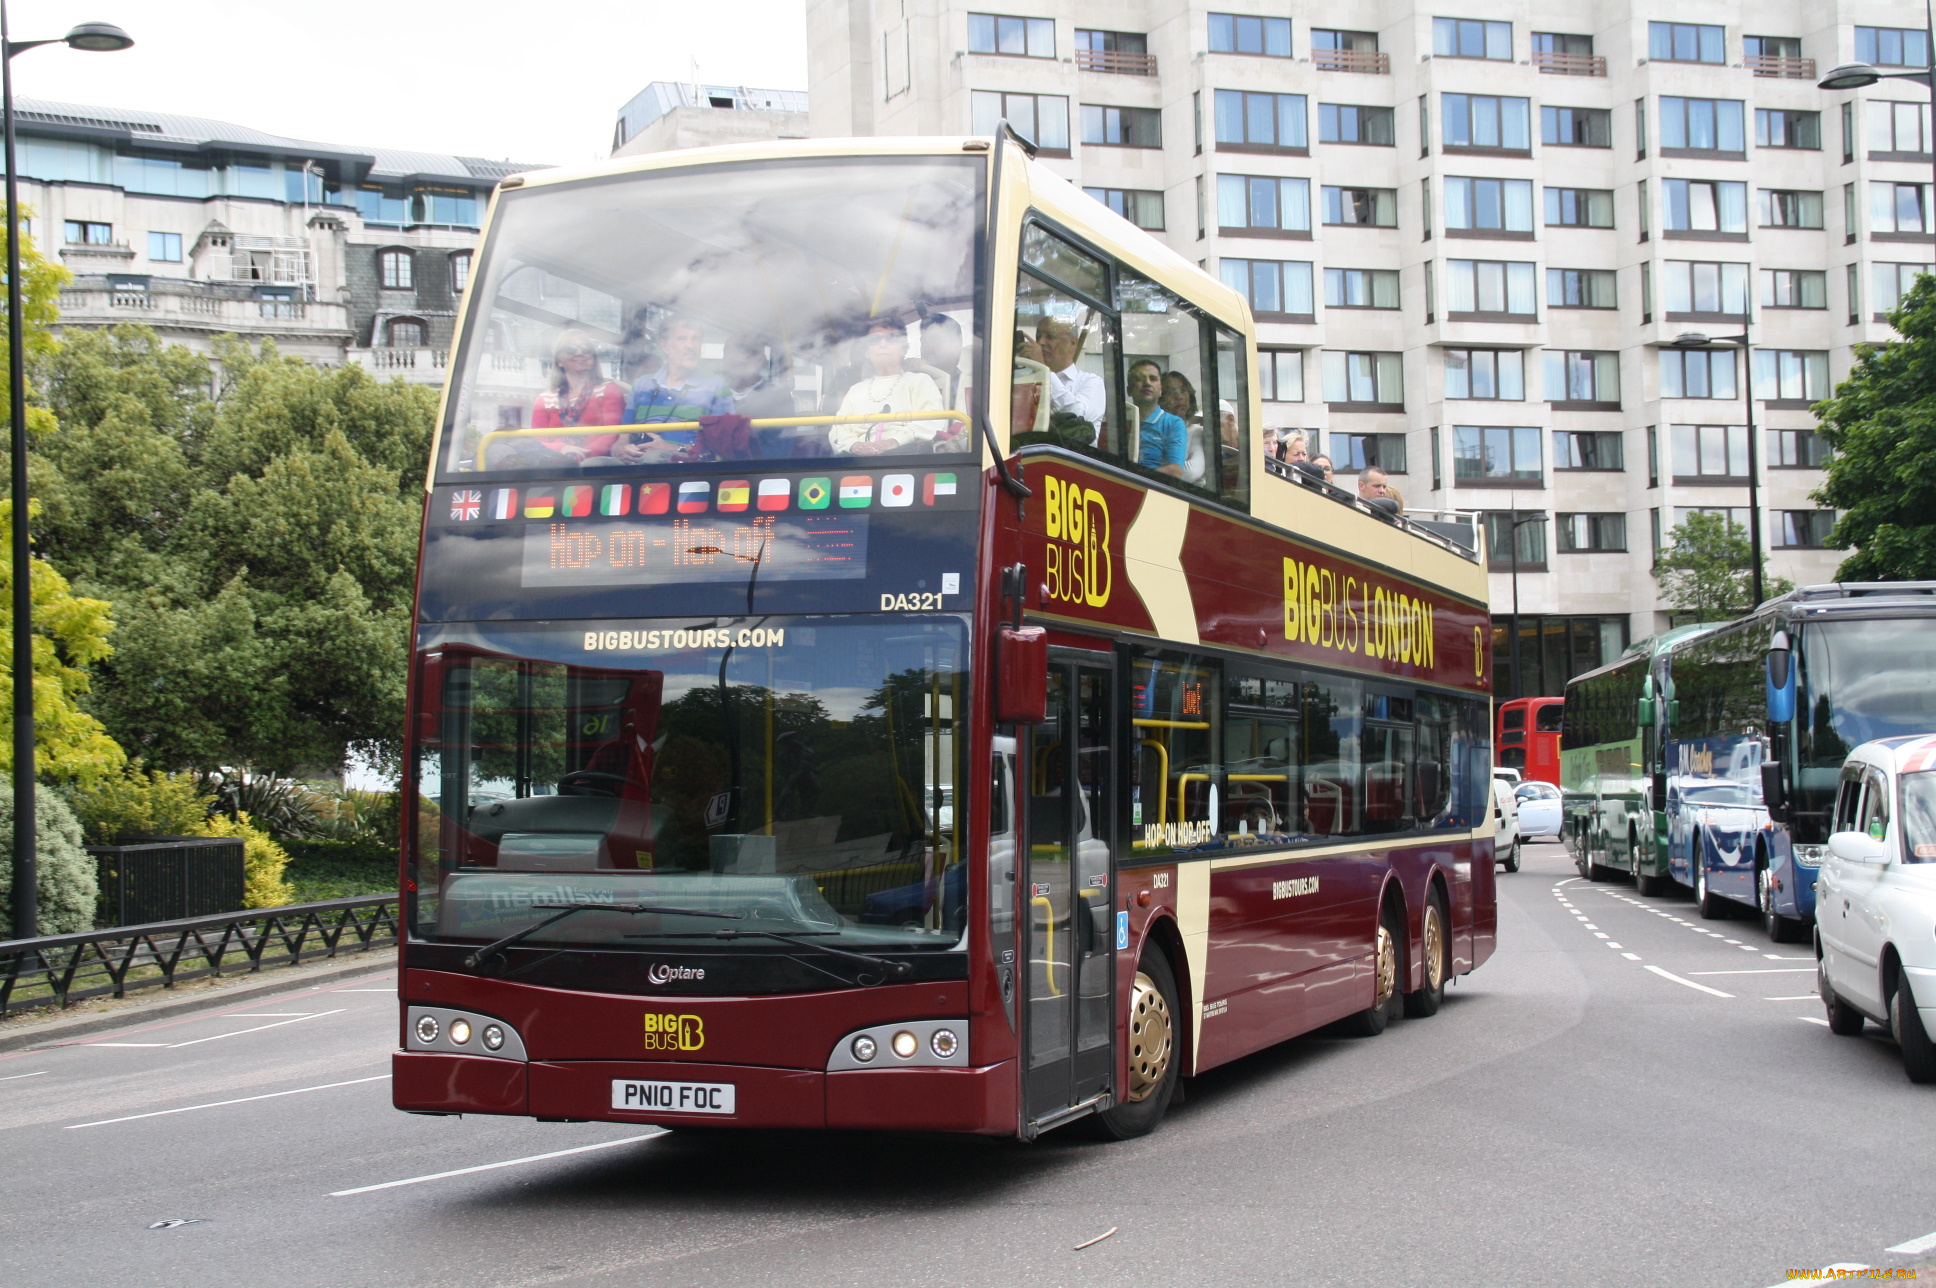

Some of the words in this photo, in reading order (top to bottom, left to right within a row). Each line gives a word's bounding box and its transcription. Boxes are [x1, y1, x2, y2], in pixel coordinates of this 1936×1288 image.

[1045, 474, 1083, 544] BIG
[551, 523, 602, 569] Hop
[609, 530, 645, 567] on
[673, 518, 726, 565] Hop
[734, 515, 776, 564] off
[1046, 543, 1084, 604] BUS
[880, 592, 943, 611] DA321
[1363, 581, 1434, 670] LONDON
[584, 628, 784, 651] BIGBUSTOURS.COM
[1144, 822, 1176, 848] HOP-ON
[1177, 820, 1211, 845] HOP-OFF
[1153, 872, 1169, 889] DA321
[1272, 875, 1320, 900] BIGBUSTOURS.COM
[656, 963, 705, 983] Optare
[644, 1013, 678, 1032] BIG
[644, 1033, 678, 1050] BUS
[625, 1084, 673, 1107] PN10
[679, 1086, 722, 1109] FOC
